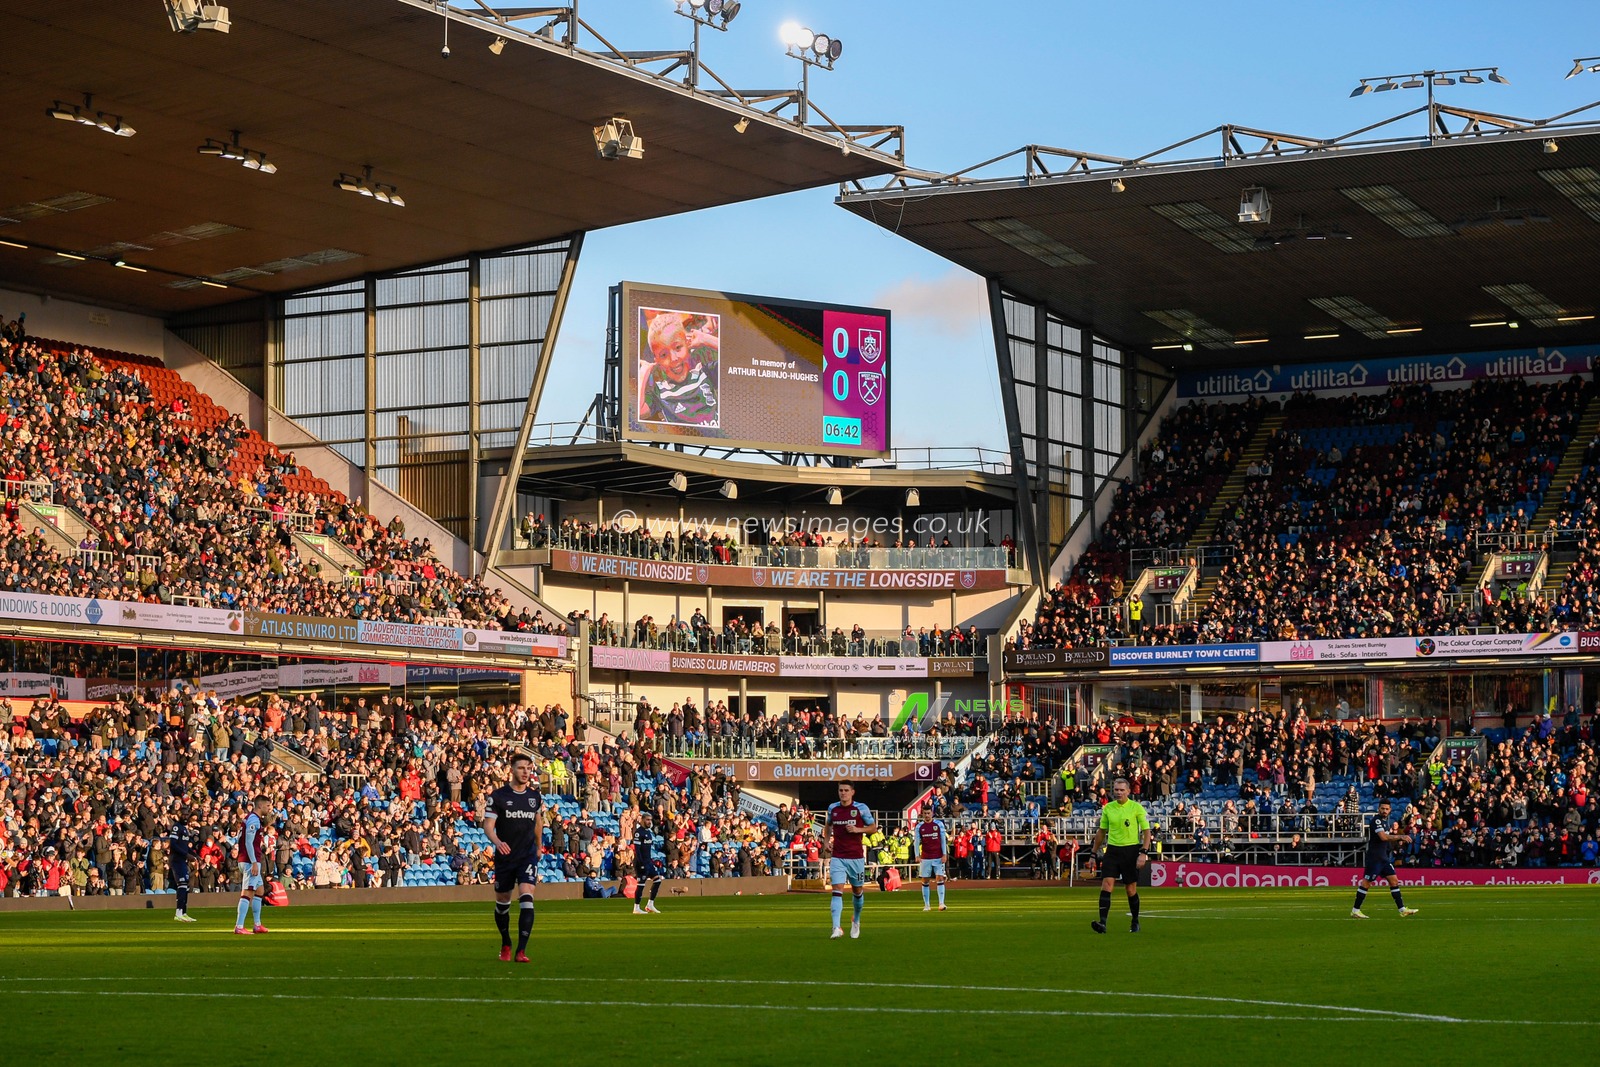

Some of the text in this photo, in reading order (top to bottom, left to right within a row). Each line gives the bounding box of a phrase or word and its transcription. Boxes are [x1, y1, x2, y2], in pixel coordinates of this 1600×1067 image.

[832, 327, 849, 359] 0
[752, 357, 796, 369] In memory of
[1486, 356, 1546, 376] utilita
[728, 366, 818, 382] ARTHUR LABINJO-HUGHES
[1291, 368, 1348, 390] utilita
[1387, 362, 1446, 383] utilita
[832, 370, 849, 401] 0
[1196, 374, 1253, 396] utilita
[825, 423, 858, 438] 06:42
[582, 556, 694, 582] WE ARE THE LONGSIDE
[771, 570, 955, 588] WE ARE THE LONGSIDE
[40, 602, 48, 615] &
[51, 602, 81, 617] DOORS
[260, 620, 356, 640] ATLAS ENVIRO LTD
[364, 622, 372, 632] TO
[373, 623, 408, 634] ADVERTISE
[410, 626, 425, 636] HERE
[426, 628, 457, 638] CONTACT:
[1016, 653, 1056, 664] BOWLAND
[1065, 651, 1105, 662] BOWLAND
[1112, 648, 1256, 660] DISCOVER BURNLEY TOWN CENTRE
[672, 657, 776, 674] BUSINESS CLUB MEMBERS
[827, 663, 850, 672] Group
[774, 764, 893, 780] @BurnleyOfficial
[505, 810, 535, 821] betway
[526, 865, 538, 876] 41
[1176, 864, 1330, 888] foodpanda
